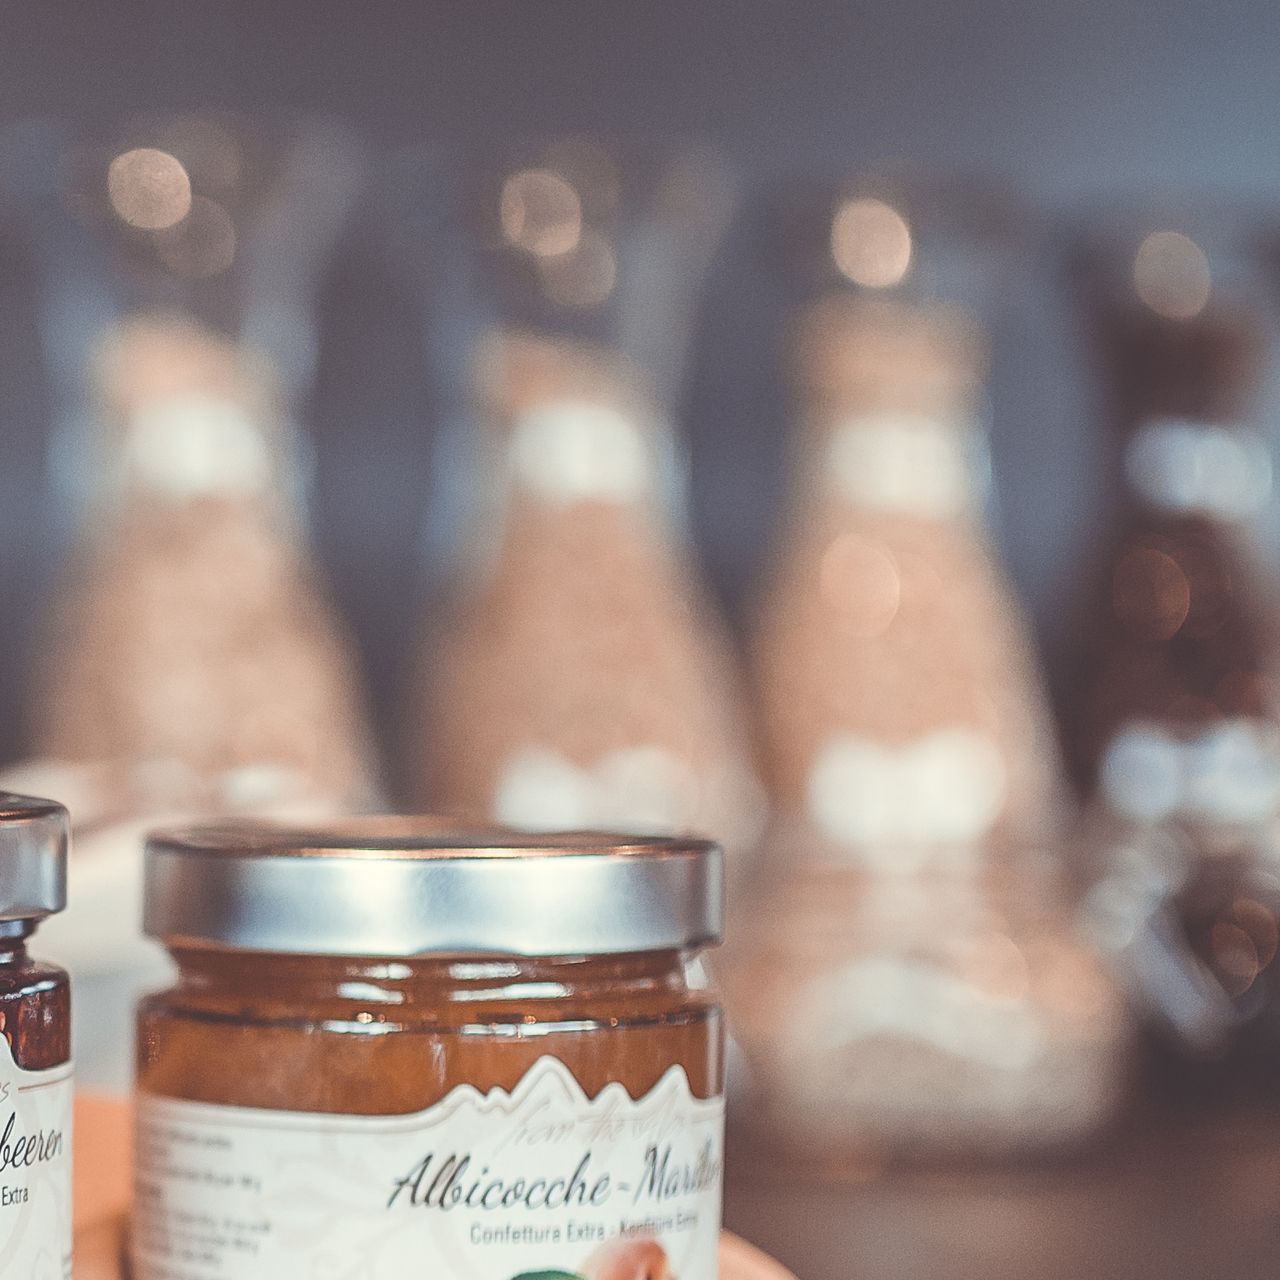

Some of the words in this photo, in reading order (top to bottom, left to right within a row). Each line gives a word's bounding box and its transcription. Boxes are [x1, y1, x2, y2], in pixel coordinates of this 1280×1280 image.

[385, 1150, 611, 1212] Albicocche
[2, 1185, 29, 1207] Extra
[470, 1220, 561, 1246] Confettura
